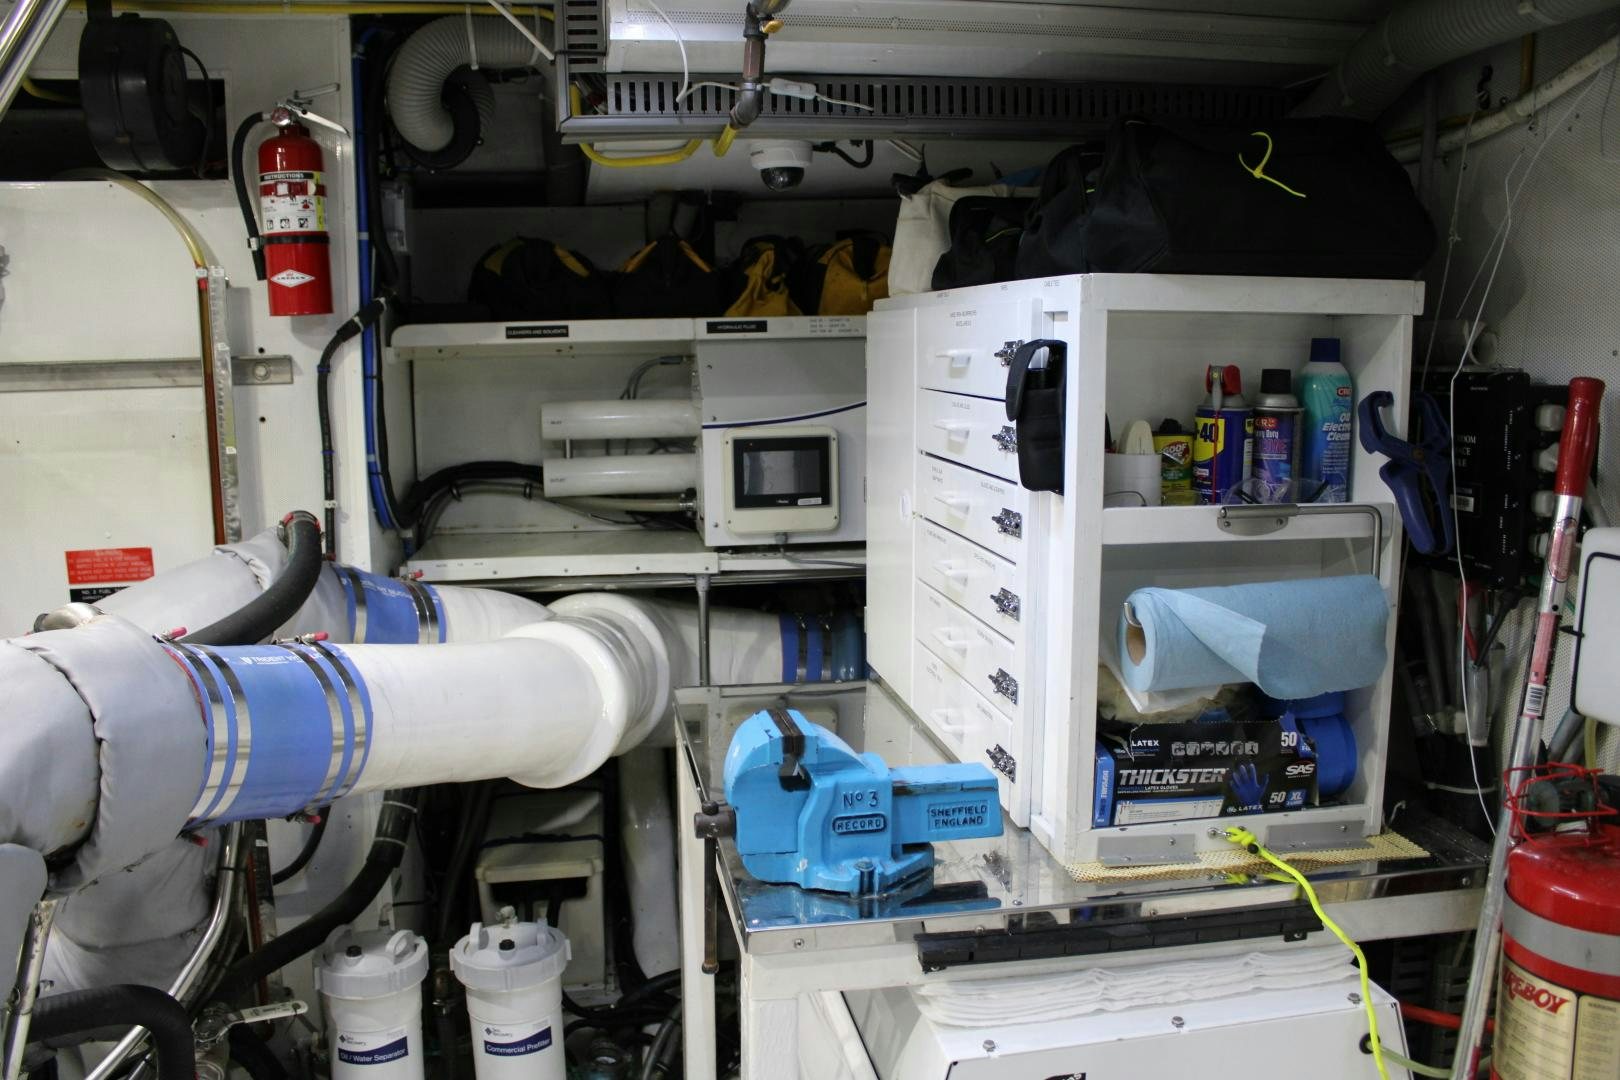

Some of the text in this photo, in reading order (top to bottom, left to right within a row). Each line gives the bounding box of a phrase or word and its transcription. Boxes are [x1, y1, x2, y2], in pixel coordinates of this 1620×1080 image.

[1131, 740, 1160, 748] LATEX
[1281, 731, 1298, 747] 50
[1285, 763, 1316, 776] SAS
[1119, 767, 1227, 786] THICKSTER
[869, 790, 879, 807] 3
[1269, 791, 1287, 804] 50
[931, 805, 988, 817] SHEFFIELD
[1238, 804, 1264, 812] LATEX
[837, 818, 881, 831] RECORD
[935, 816, 983, 828] ENGLAND
[486, 1039, 551, 1054] Commercial Prefilter
[353, 1054, 373, 1062] Water
[373, 1048, 407, 1062] Separator
